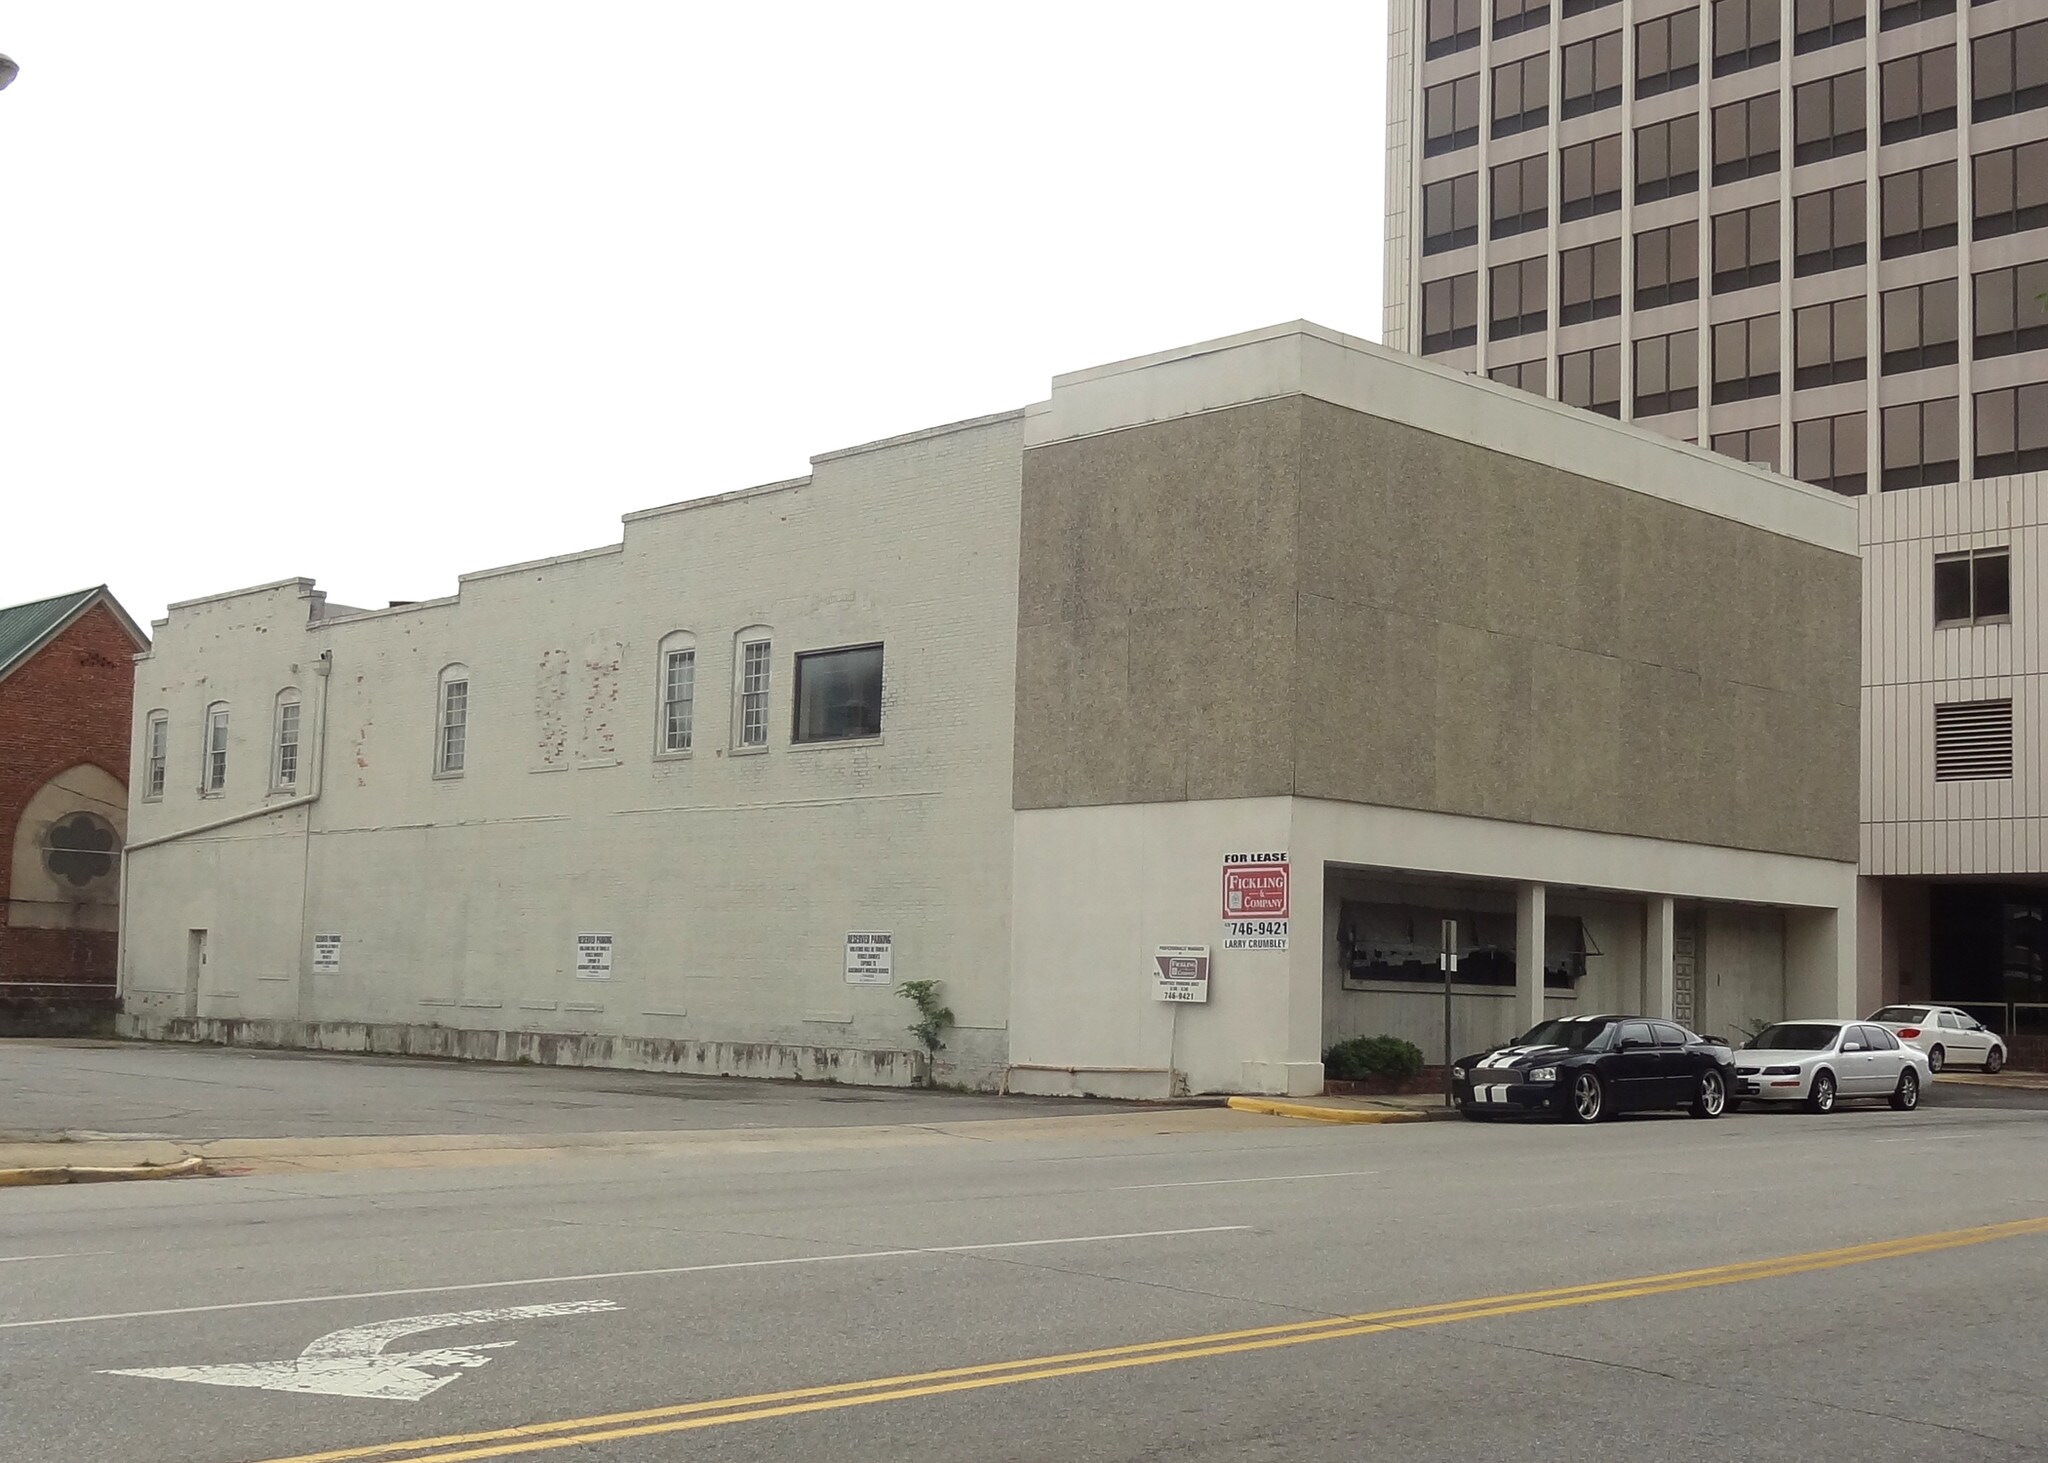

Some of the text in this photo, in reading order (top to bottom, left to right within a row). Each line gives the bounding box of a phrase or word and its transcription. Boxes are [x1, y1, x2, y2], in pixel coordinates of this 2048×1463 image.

[1224, 852, 1287, 863] FOR LEASE
[1229, 875, 1284, 889] FICKLING
[1244, 896, 1282, 908] COMPANY
[1231, 922, 1288, 936] 746-9421
[848, 934, 891, 944] RESERVED PARKING
[1224, 939, 1286, 948] LARRY CRUMBLEY
